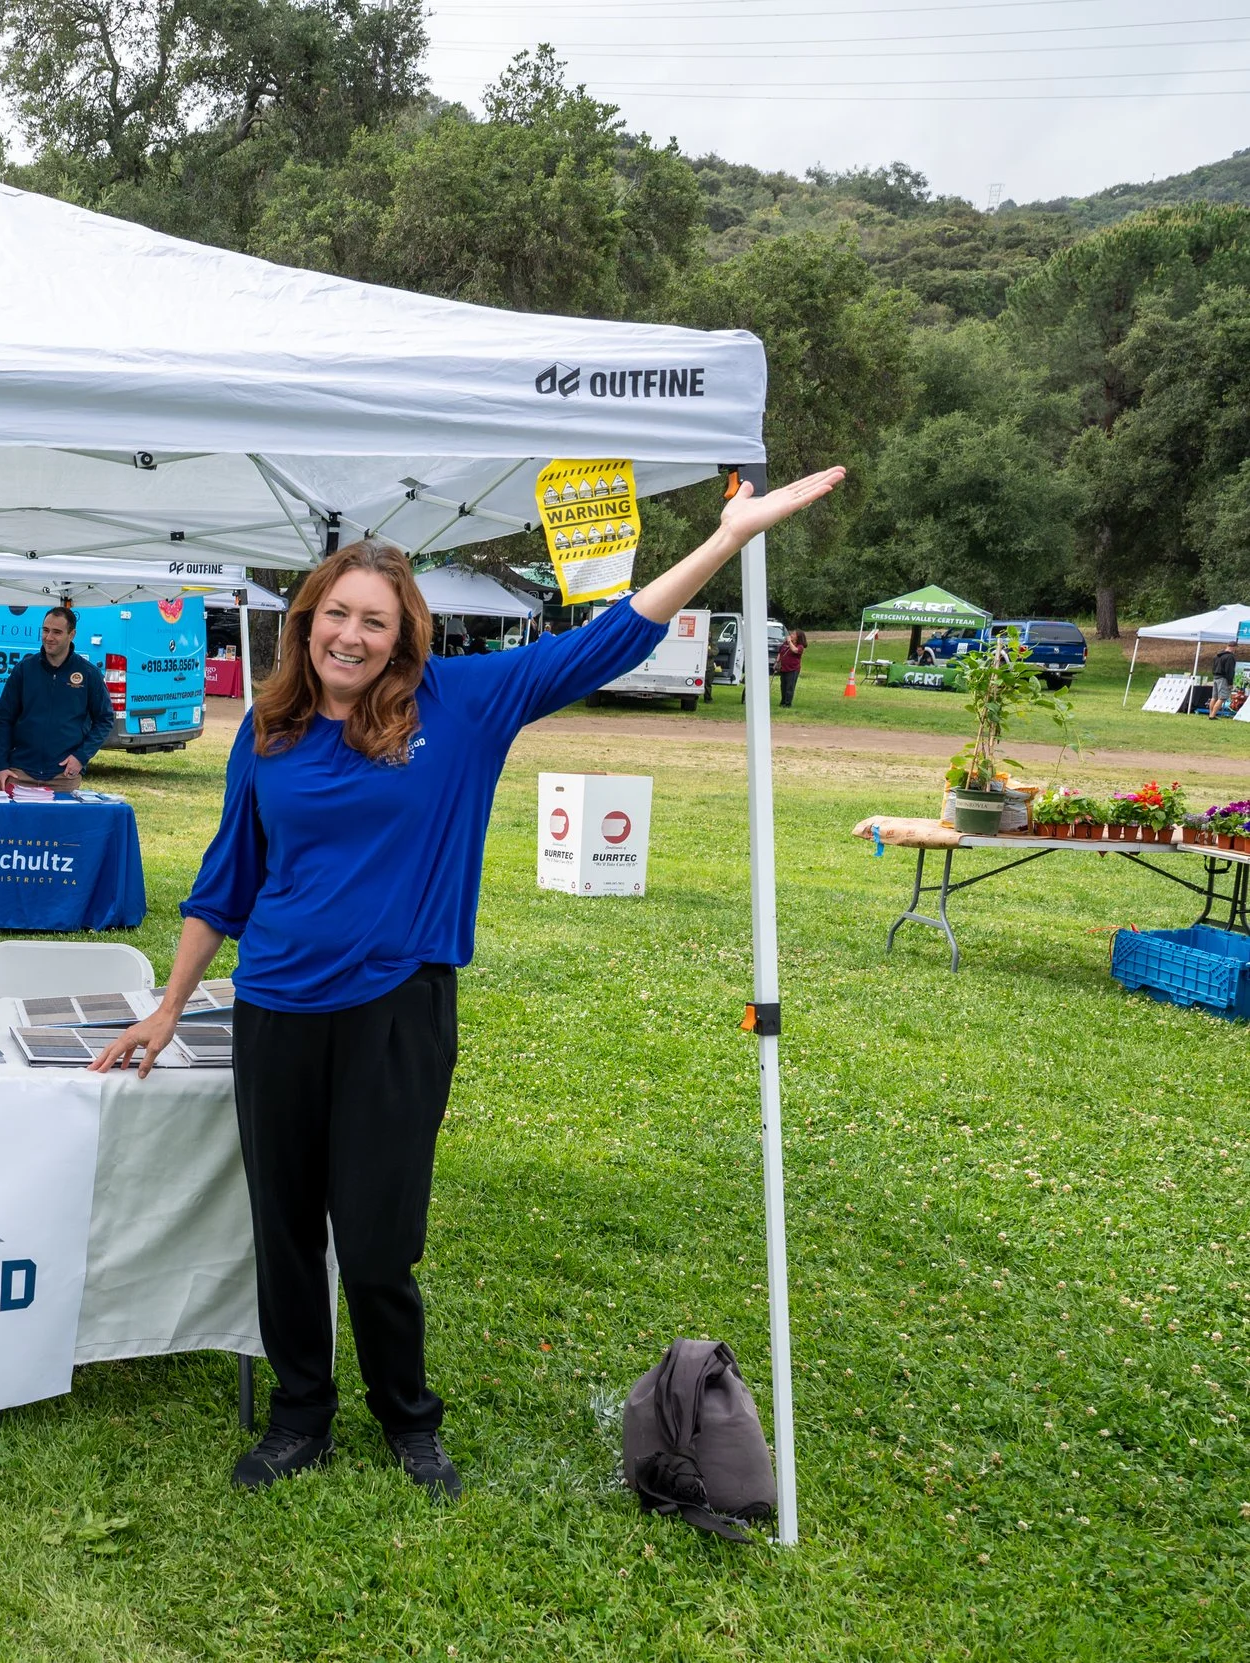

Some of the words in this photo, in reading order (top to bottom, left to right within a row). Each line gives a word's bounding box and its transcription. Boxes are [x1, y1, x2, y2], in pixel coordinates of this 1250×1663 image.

[589, 368, 705, 398] OUTFINE
[547, 500, 631, 524] WARNING
[186, 563, 223, 574] OUTFINE
[893, 600, 956, 612] CERT
[871, 613, 910, 621] CRESCENTA
[911, 614, 936, 623] VALLEY
[147, 659, 195, 673] 818.336.8567
[904, 671, 944, 686] CERT
[544, 849, 574, 860] BURRTEC
[592, 853, 638, 862] BURRTEC
